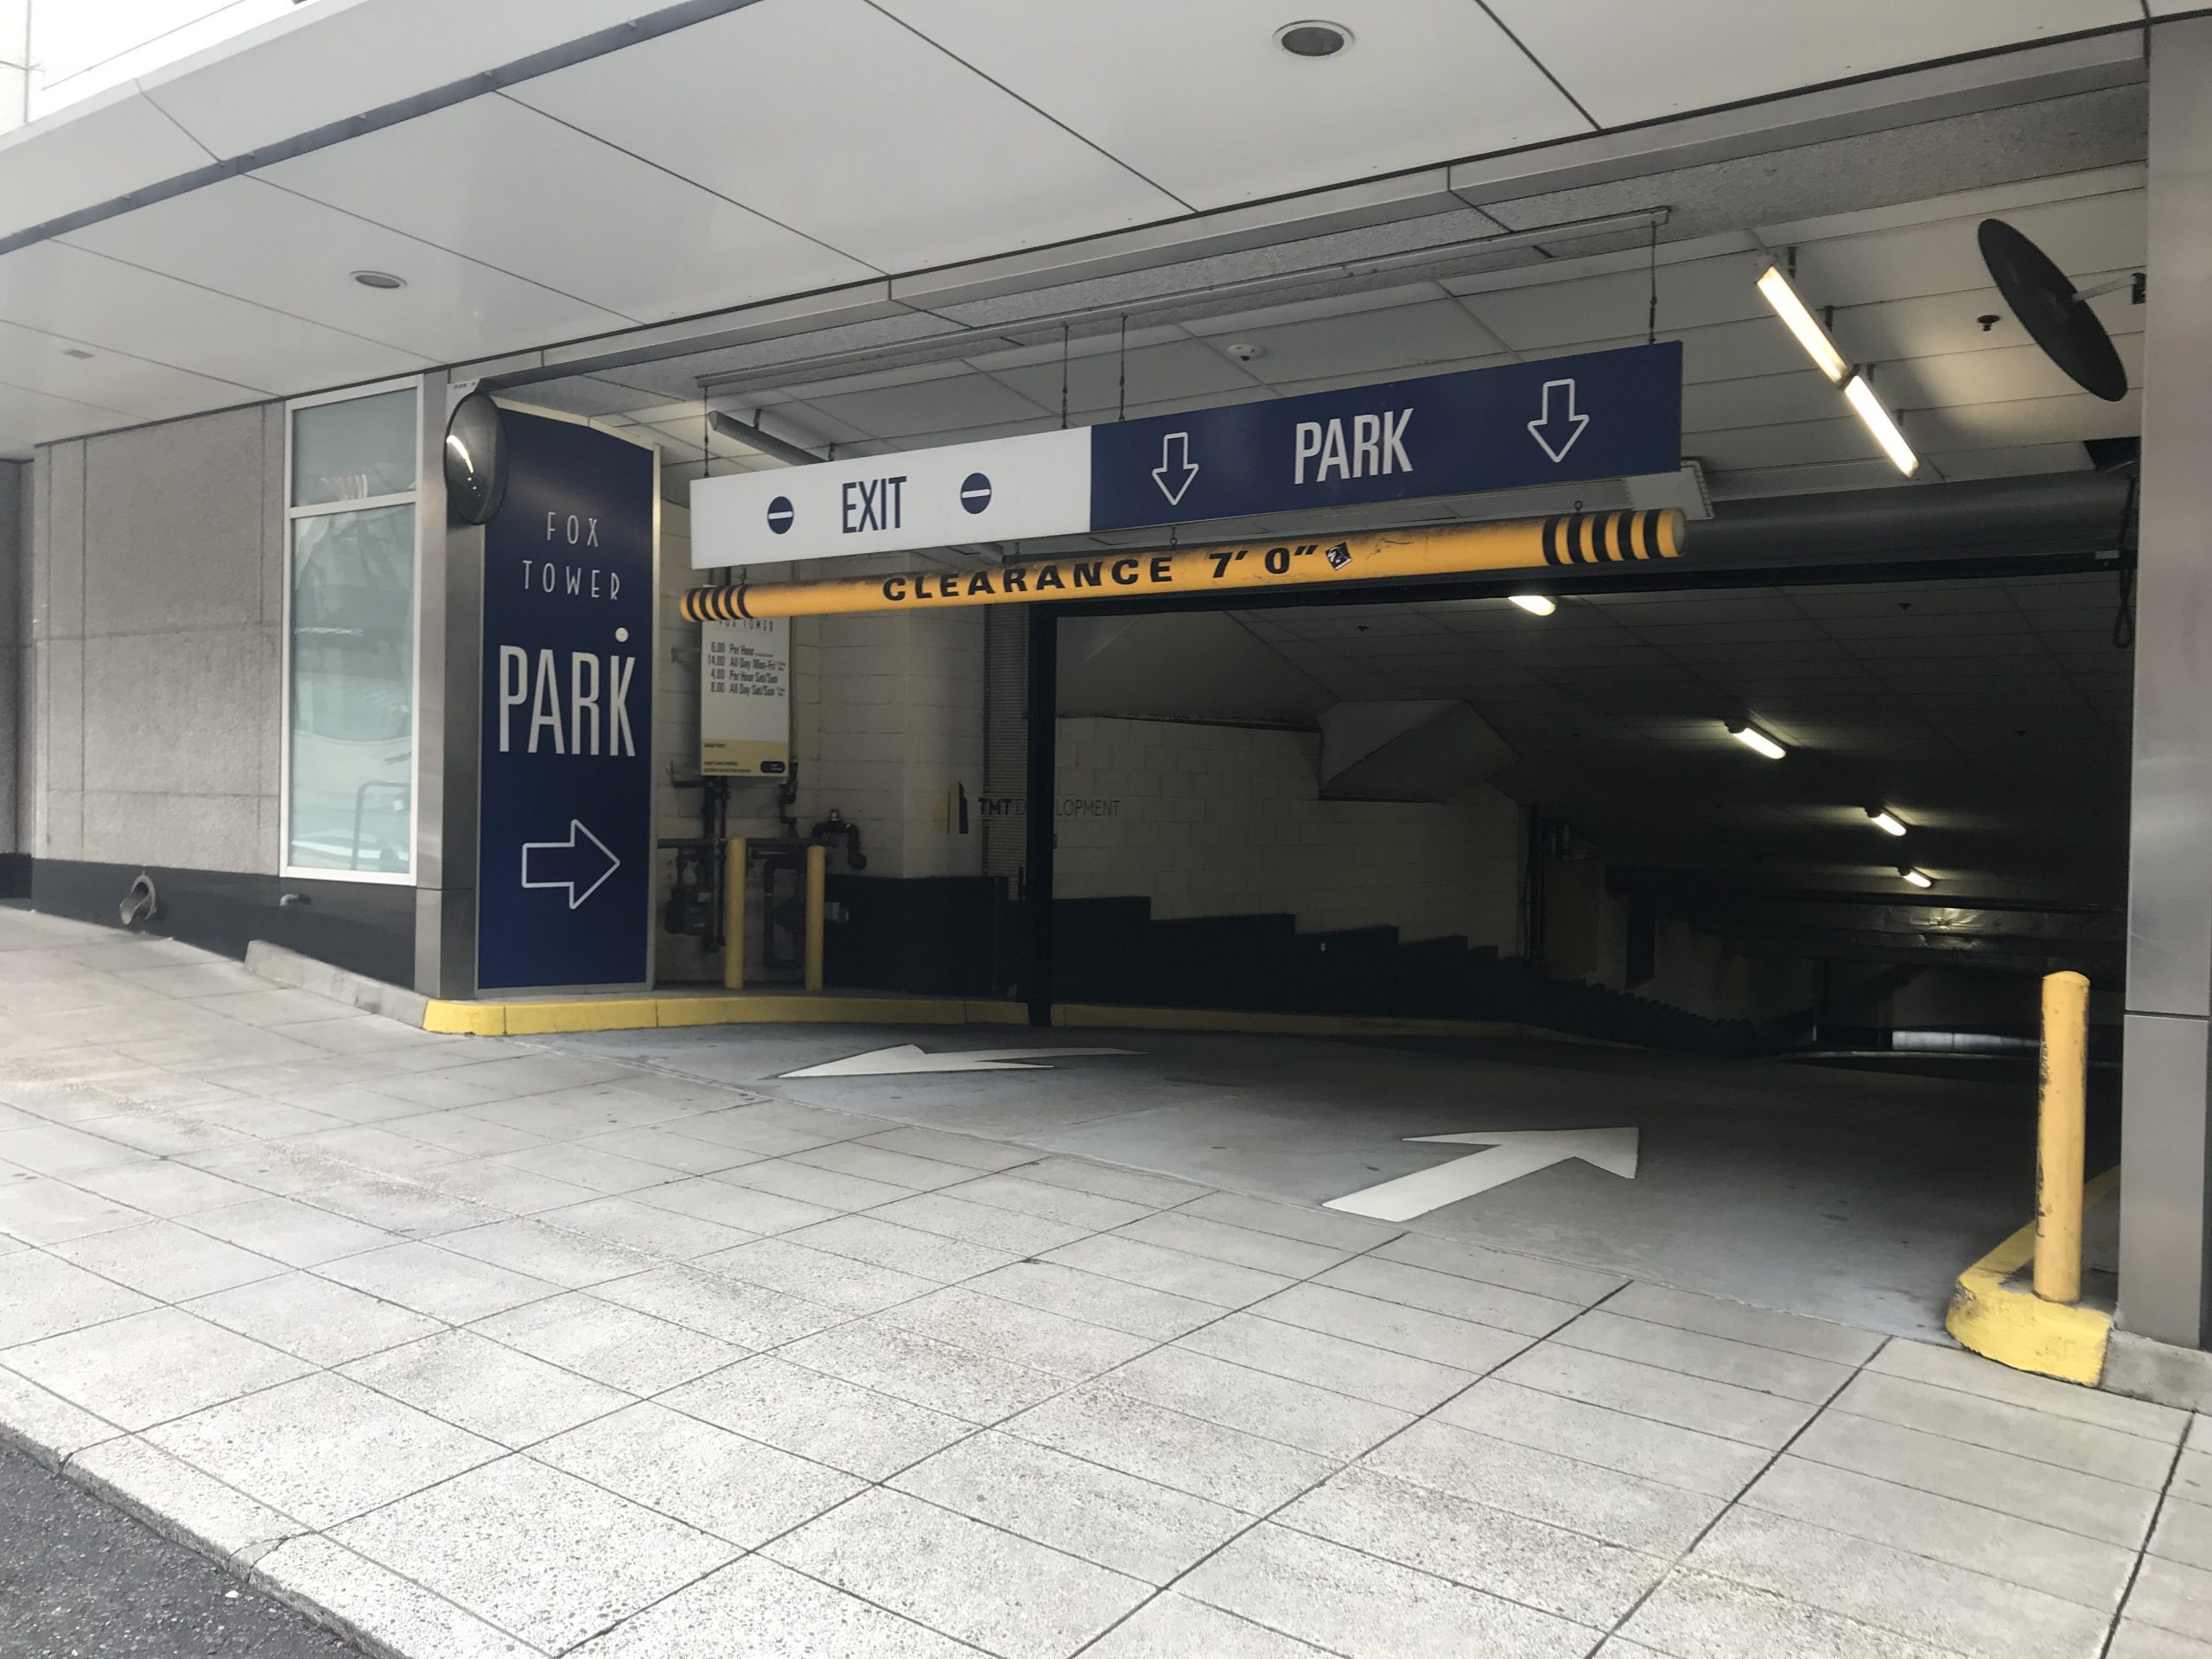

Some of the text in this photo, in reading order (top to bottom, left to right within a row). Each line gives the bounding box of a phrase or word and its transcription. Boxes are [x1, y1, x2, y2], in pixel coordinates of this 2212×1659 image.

[1294, 408, 1414, 485] PARK
[546, 511, 599, 547] FOX
[842, 475, 907, 534] EXIT
[522, 559, 621, 601] TOWER
[882, 543, 1319, 601] CLEARANCE 7' 0"
[499, 644, 637, 757] PARK
[978, 798, 1121, 817] TMT DLOPMENT
